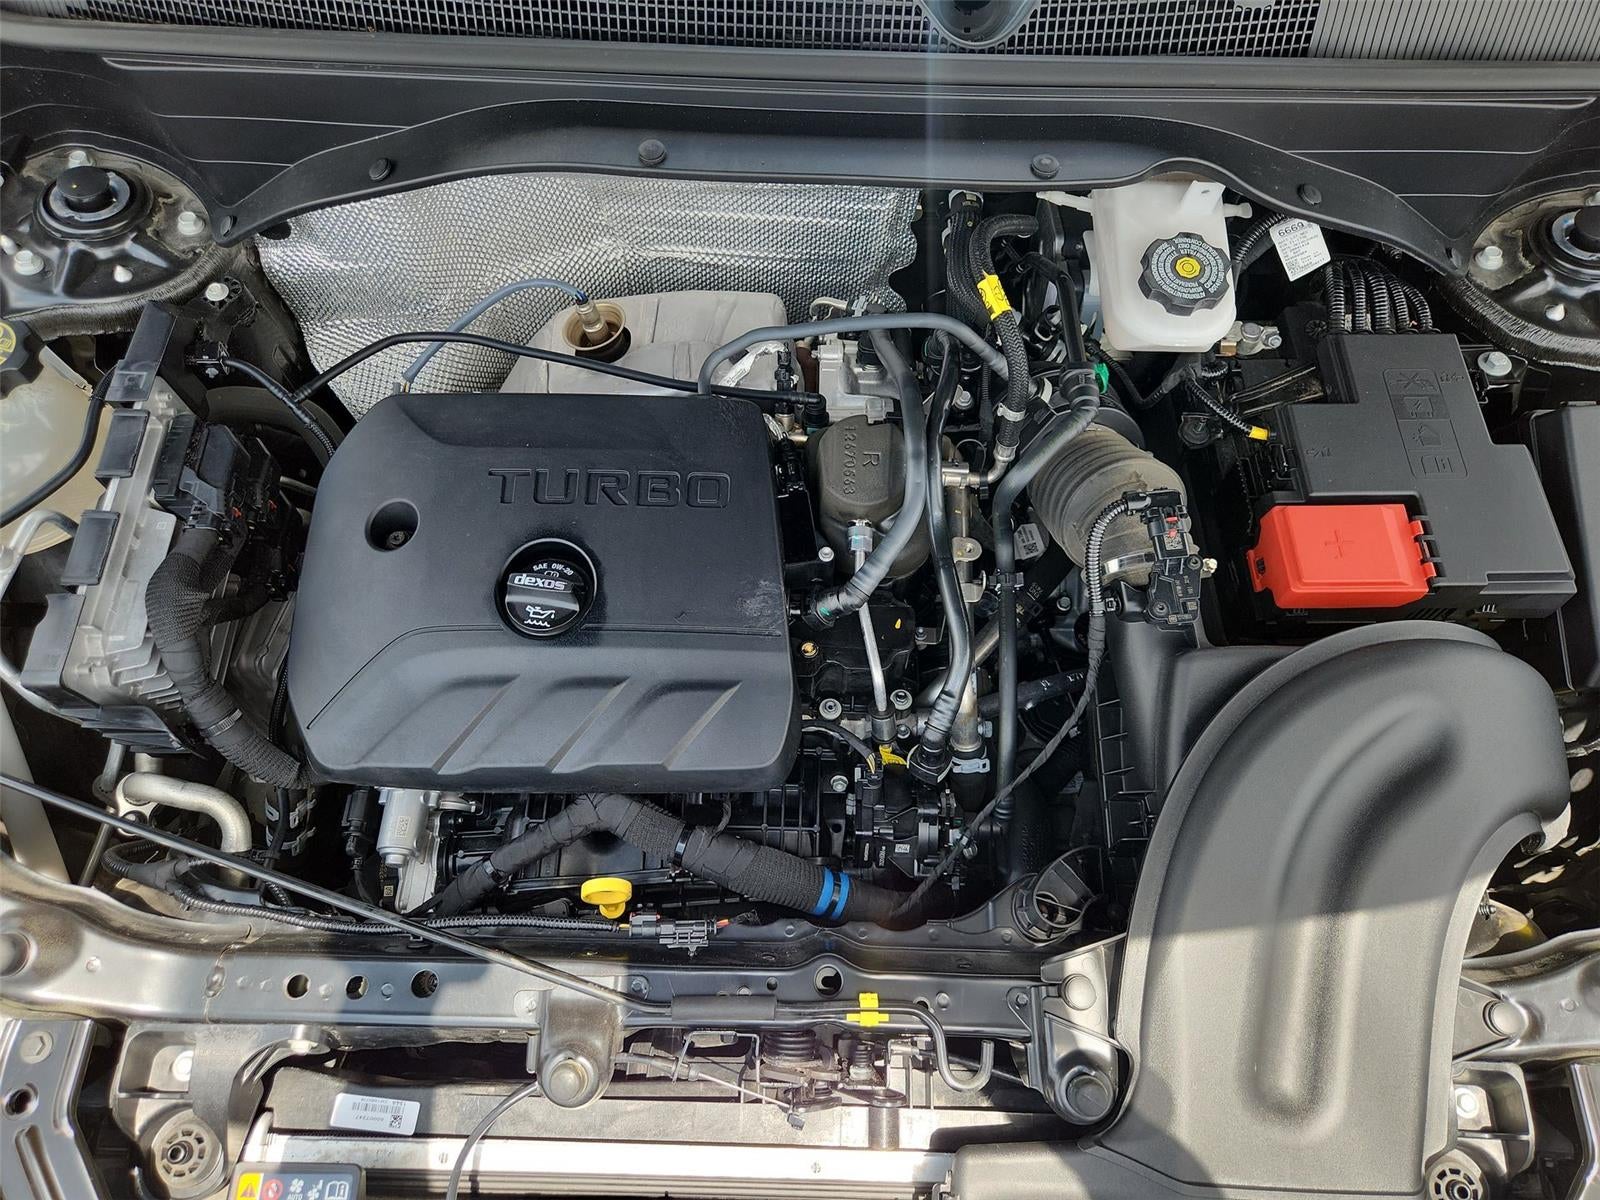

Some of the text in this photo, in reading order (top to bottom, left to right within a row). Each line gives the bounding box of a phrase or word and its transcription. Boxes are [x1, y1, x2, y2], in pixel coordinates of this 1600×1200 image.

[863, 451, 881, 467] R
[488, 468, 731, 509] TURBO
[533, 563, 574, 576] SAE 0W-20
[513, 573, 567, 591] dexos
